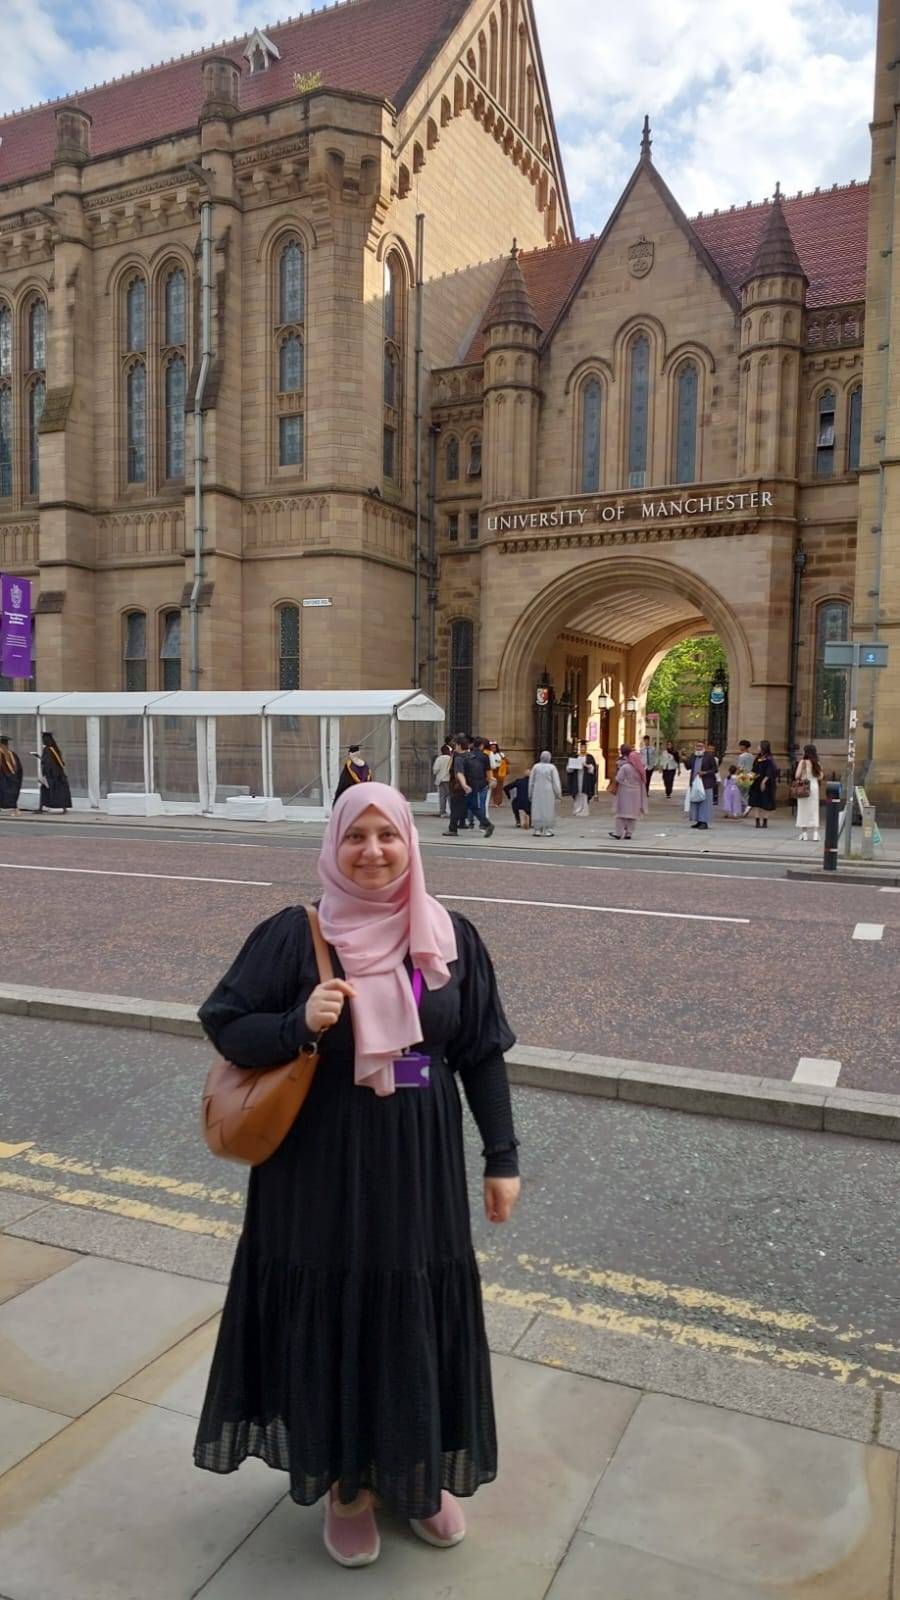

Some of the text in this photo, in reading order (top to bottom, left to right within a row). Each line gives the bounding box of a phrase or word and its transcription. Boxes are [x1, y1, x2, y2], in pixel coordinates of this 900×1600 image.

[487, 492, 773, 531] UNIVERSITY OF MANCHESTER
